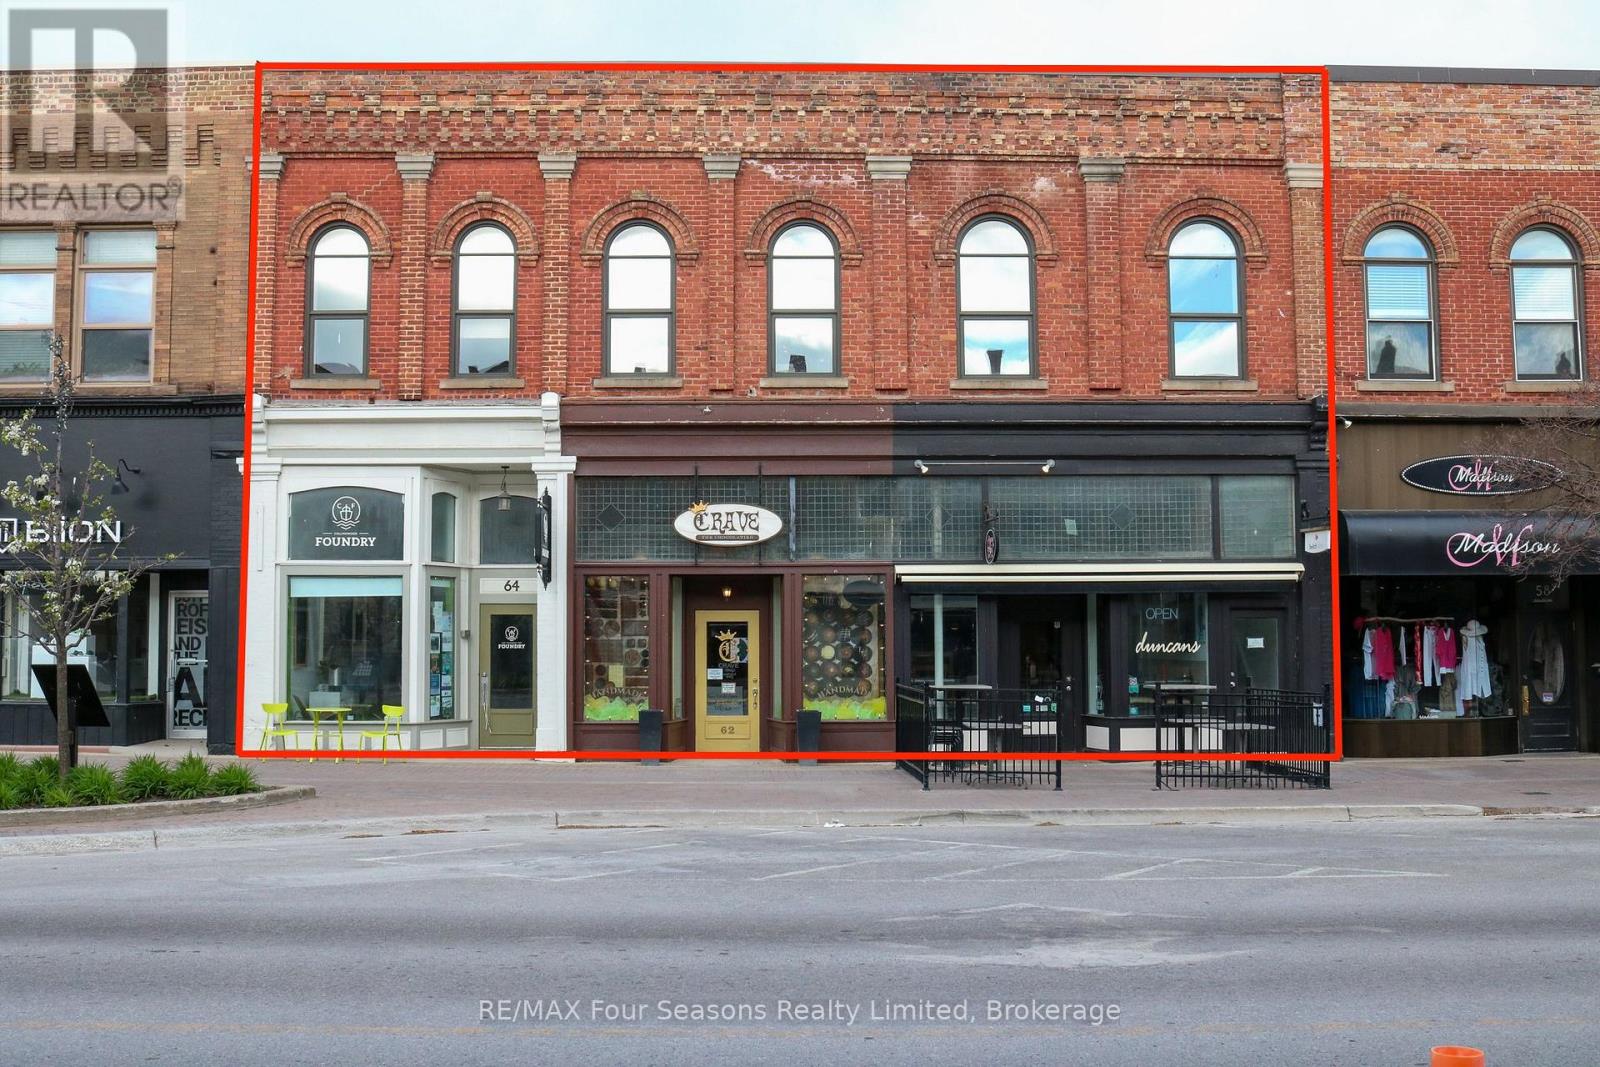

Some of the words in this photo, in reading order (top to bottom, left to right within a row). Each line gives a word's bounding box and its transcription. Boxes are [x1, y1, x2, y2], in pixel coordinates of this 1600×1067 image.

[1454, 466, 1515, 483] Madison
[694, 510, 759, 534] CRAVE
[315, 536, 376, 547] FOUNDRY
[1454, 533, 1560, 554] Madison
[504, 580, 519, 592] 64
[1145, 607, 1179, 619] OPEN
[1135, 631, 1201, 654] duncans
[720, 726, 735, 735] 62
